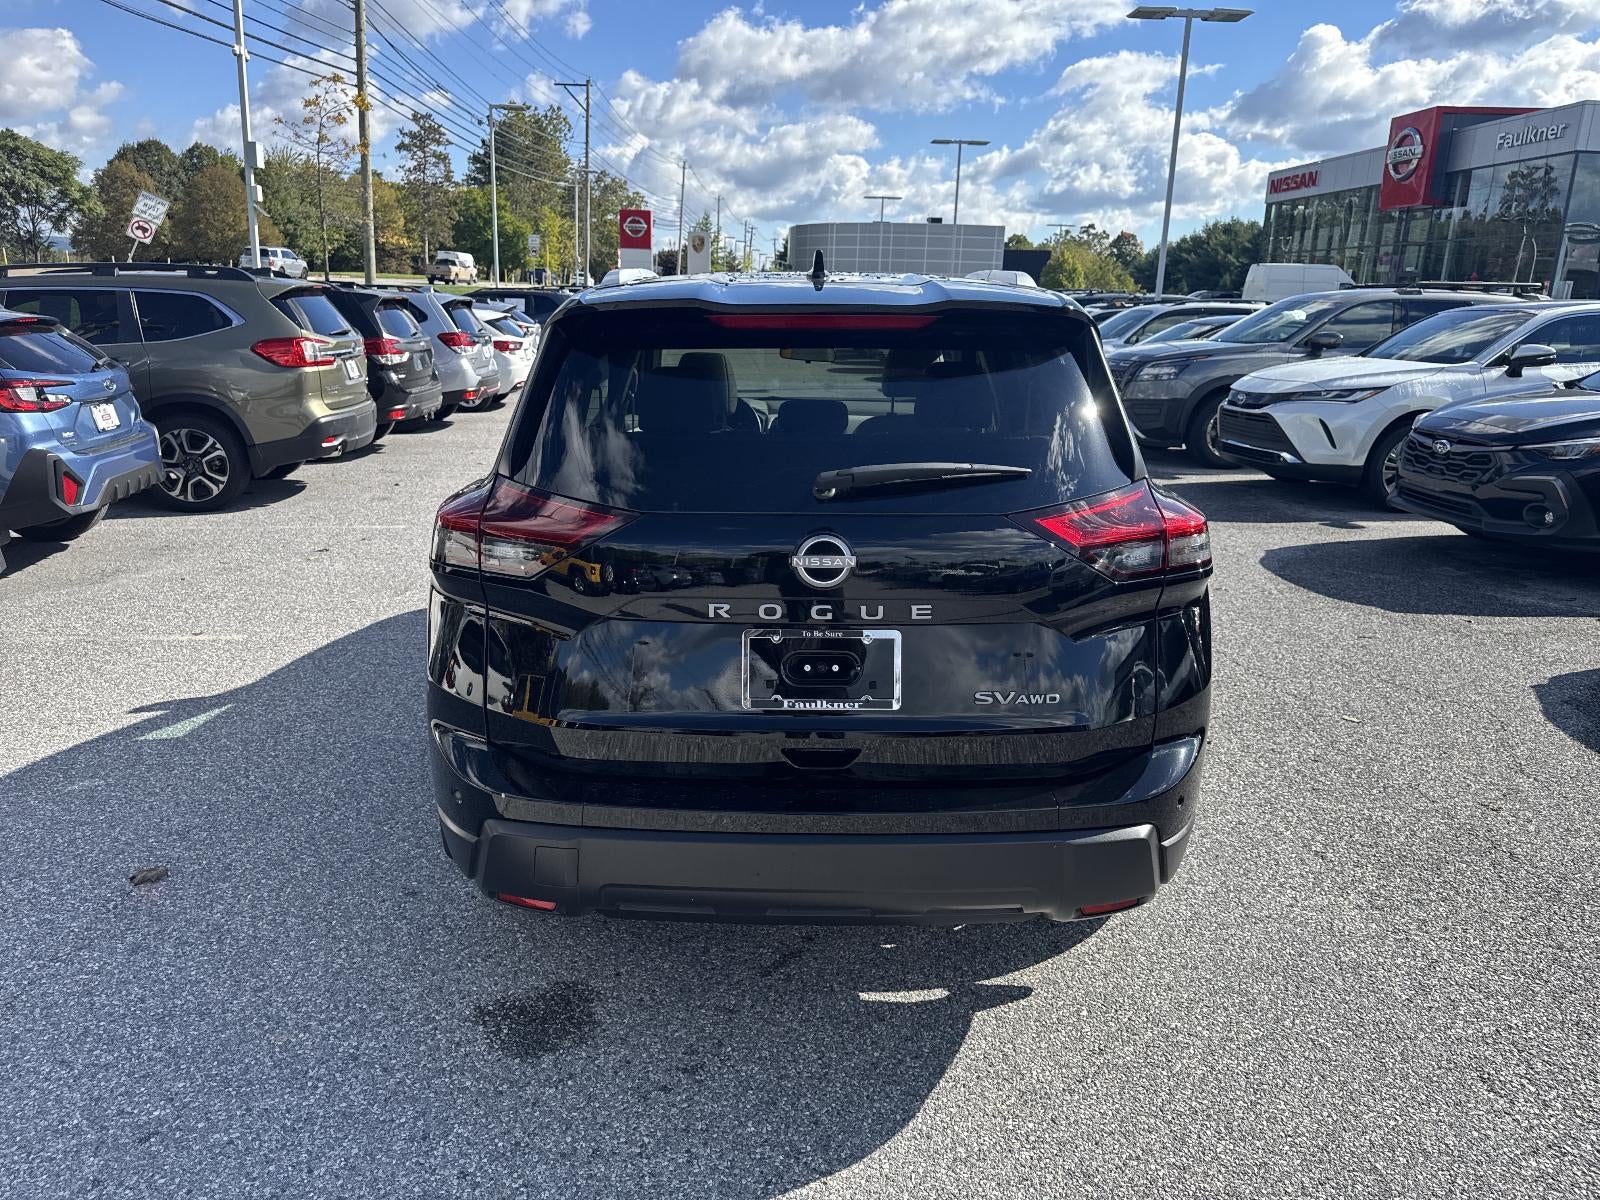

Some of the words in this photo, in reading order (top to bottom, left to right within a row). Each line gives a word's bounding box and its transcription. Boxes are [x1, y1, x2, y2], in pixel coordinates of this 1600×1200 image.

[1495, 123, 1566, 150] Faulkner
[1269, 170, 1318, 194] NISSAN
[793, 557, 855, 567] NISSAN
[707, 602, 934, 621] ROGUE
[801, 629, 812, 638] To
[813, 629, 824, 638] Be
[824, 629, 844, 638] Sure
[782, 699, 864, 710] Faulkner
